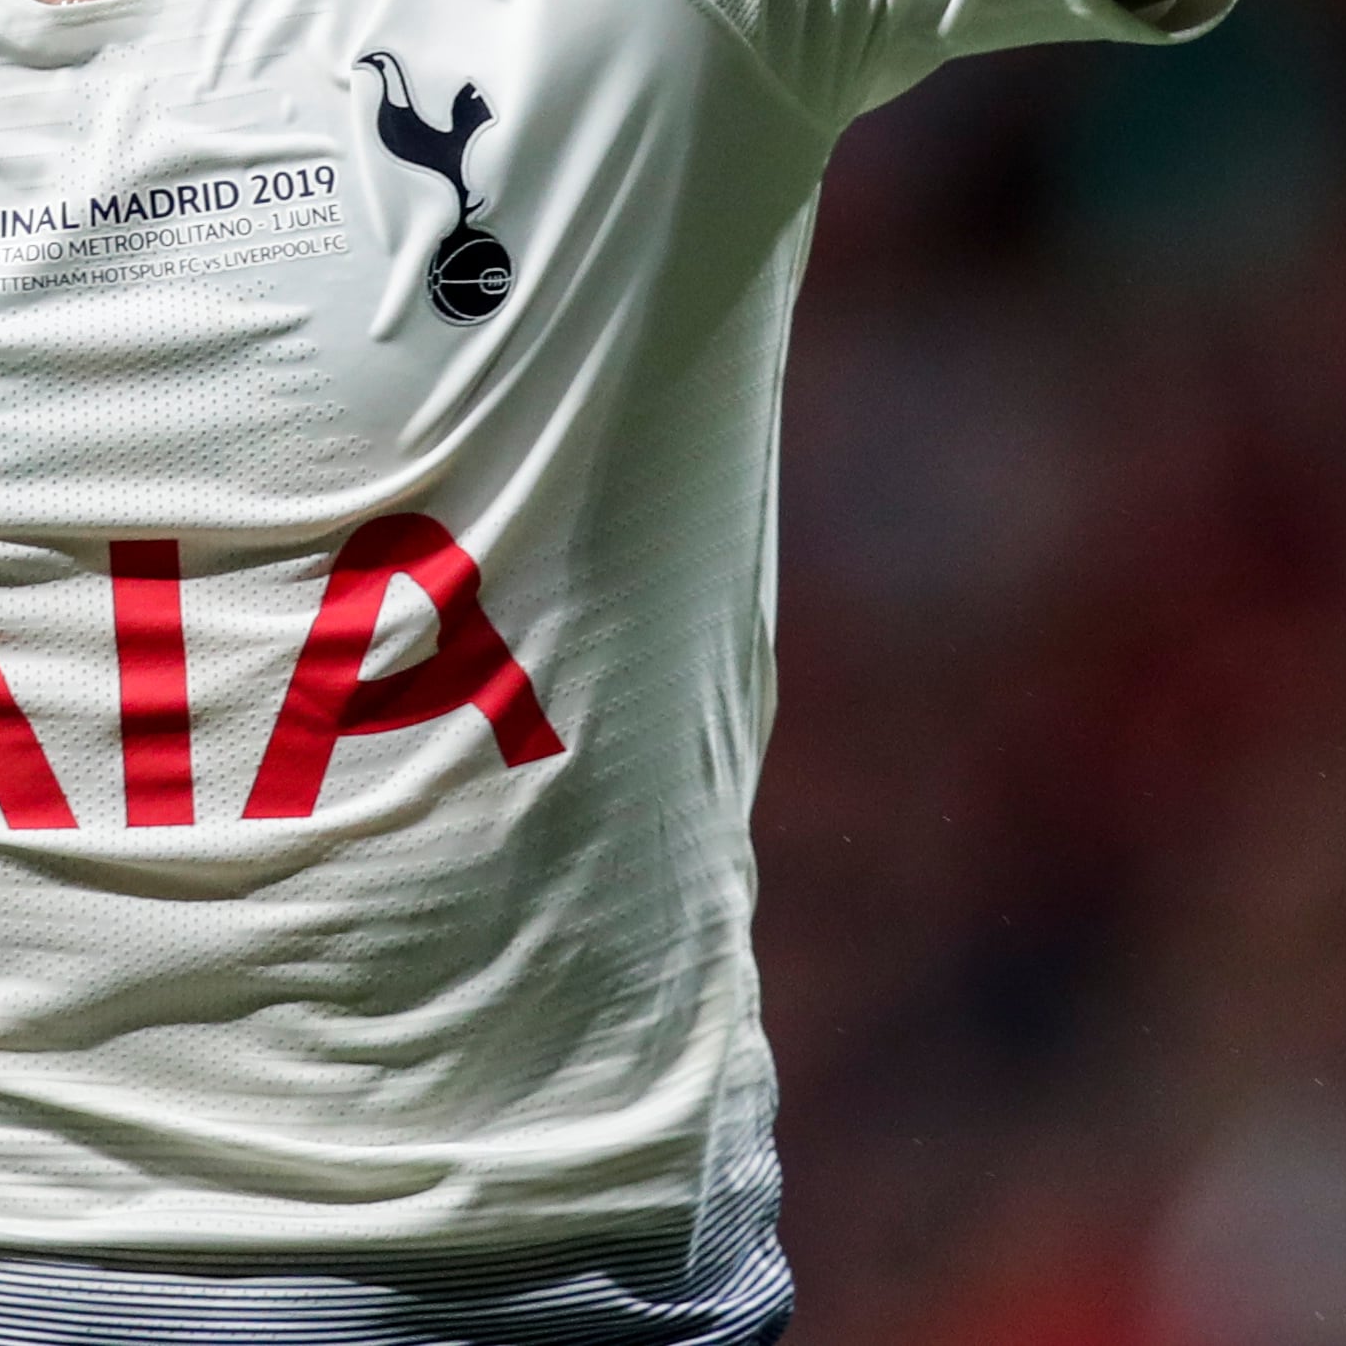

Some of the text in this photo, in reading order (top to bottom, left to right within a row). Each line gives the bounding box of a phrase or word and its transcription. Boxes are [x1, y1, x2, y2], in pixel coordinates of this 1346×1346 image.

[89, 180, 239, 227] MADRID
[251, 165, 335, 205] 2019
[69, 217, 253, 259] METROPOLITANO
[271, 212, 283, 231] 1
[287, 204, 342, 230] JUNE
[91, 260, 176, 285] HOTSPUR
[179, 256, 201, 275] FC
[203, 257, 222, 271] vs
[224, 238, 320, 268] LIVERPOOL
[323, 233, 346, 252] FC
